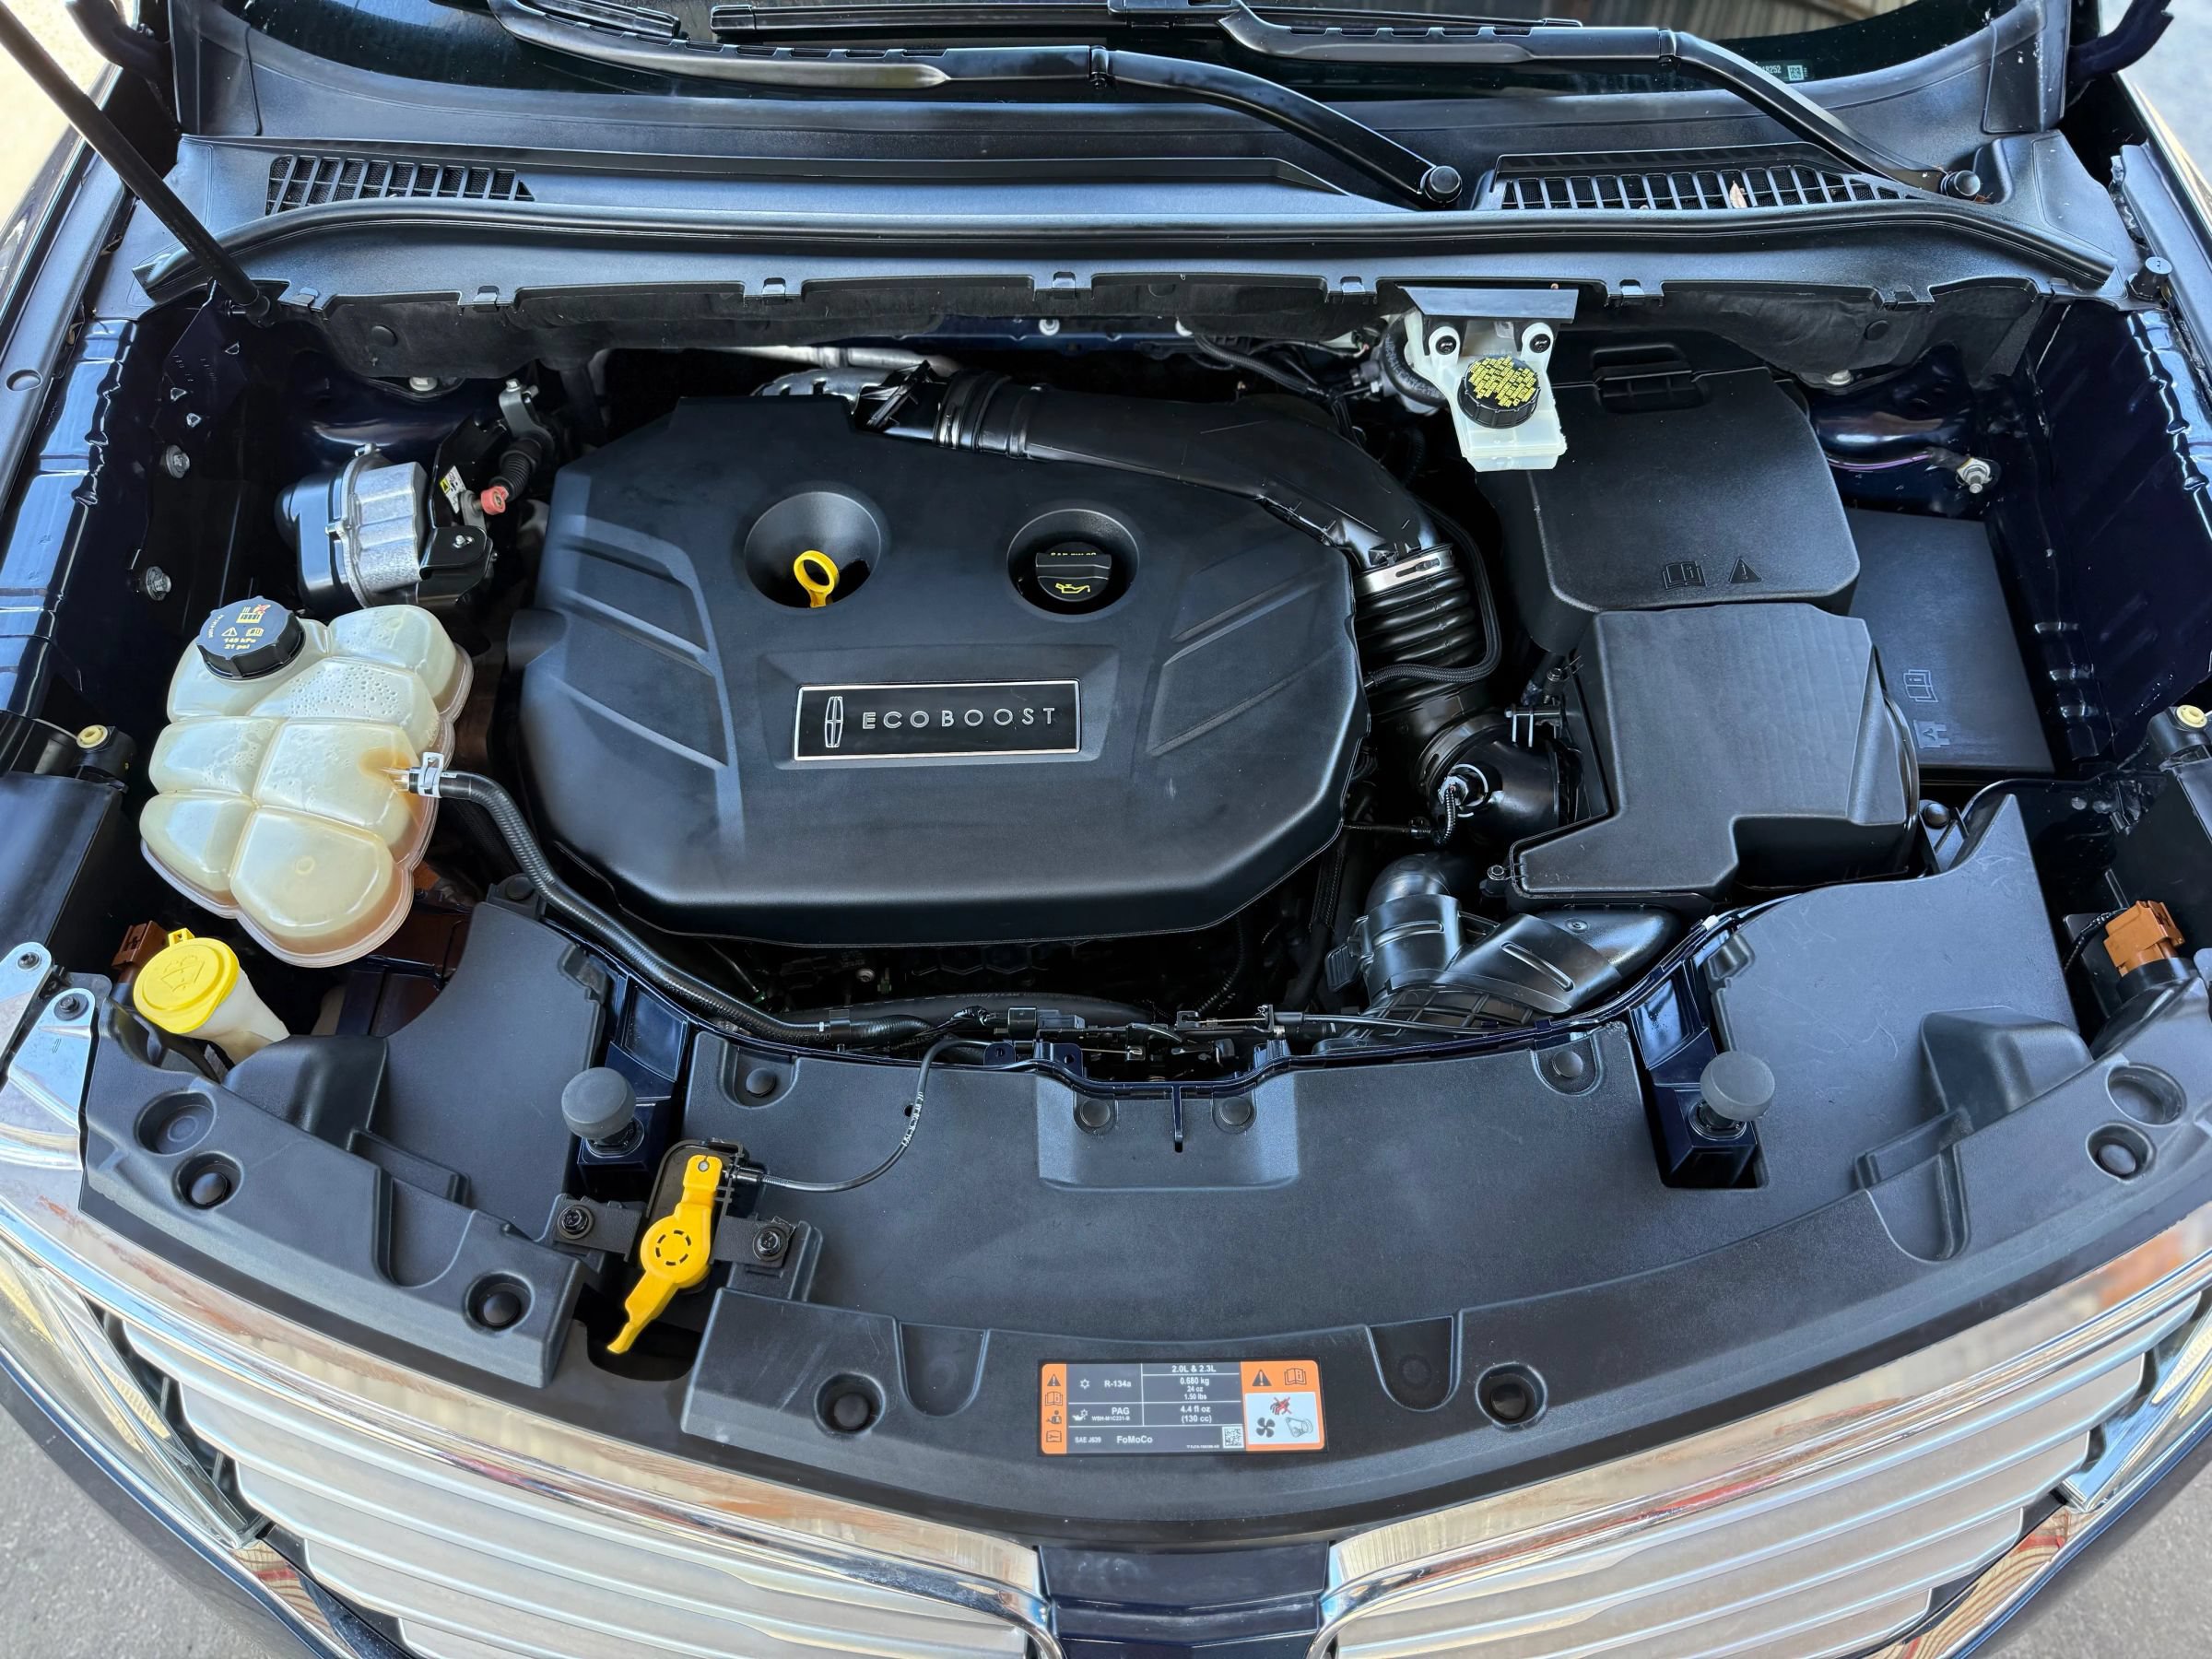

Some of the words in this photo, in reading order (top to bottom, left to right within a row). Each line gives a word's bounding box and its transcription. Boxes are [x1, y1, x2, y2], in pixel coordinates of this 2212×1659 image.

[862, 707, 1055, 729] ECOBOOST
[1200, 1377, 1210, 1386] kg
[1182, 1415, 1198, 1423] (130
[1200, 1415, 1212, 1423] cc)
[1116, 1435, 1153, 1443] FoMoCo
